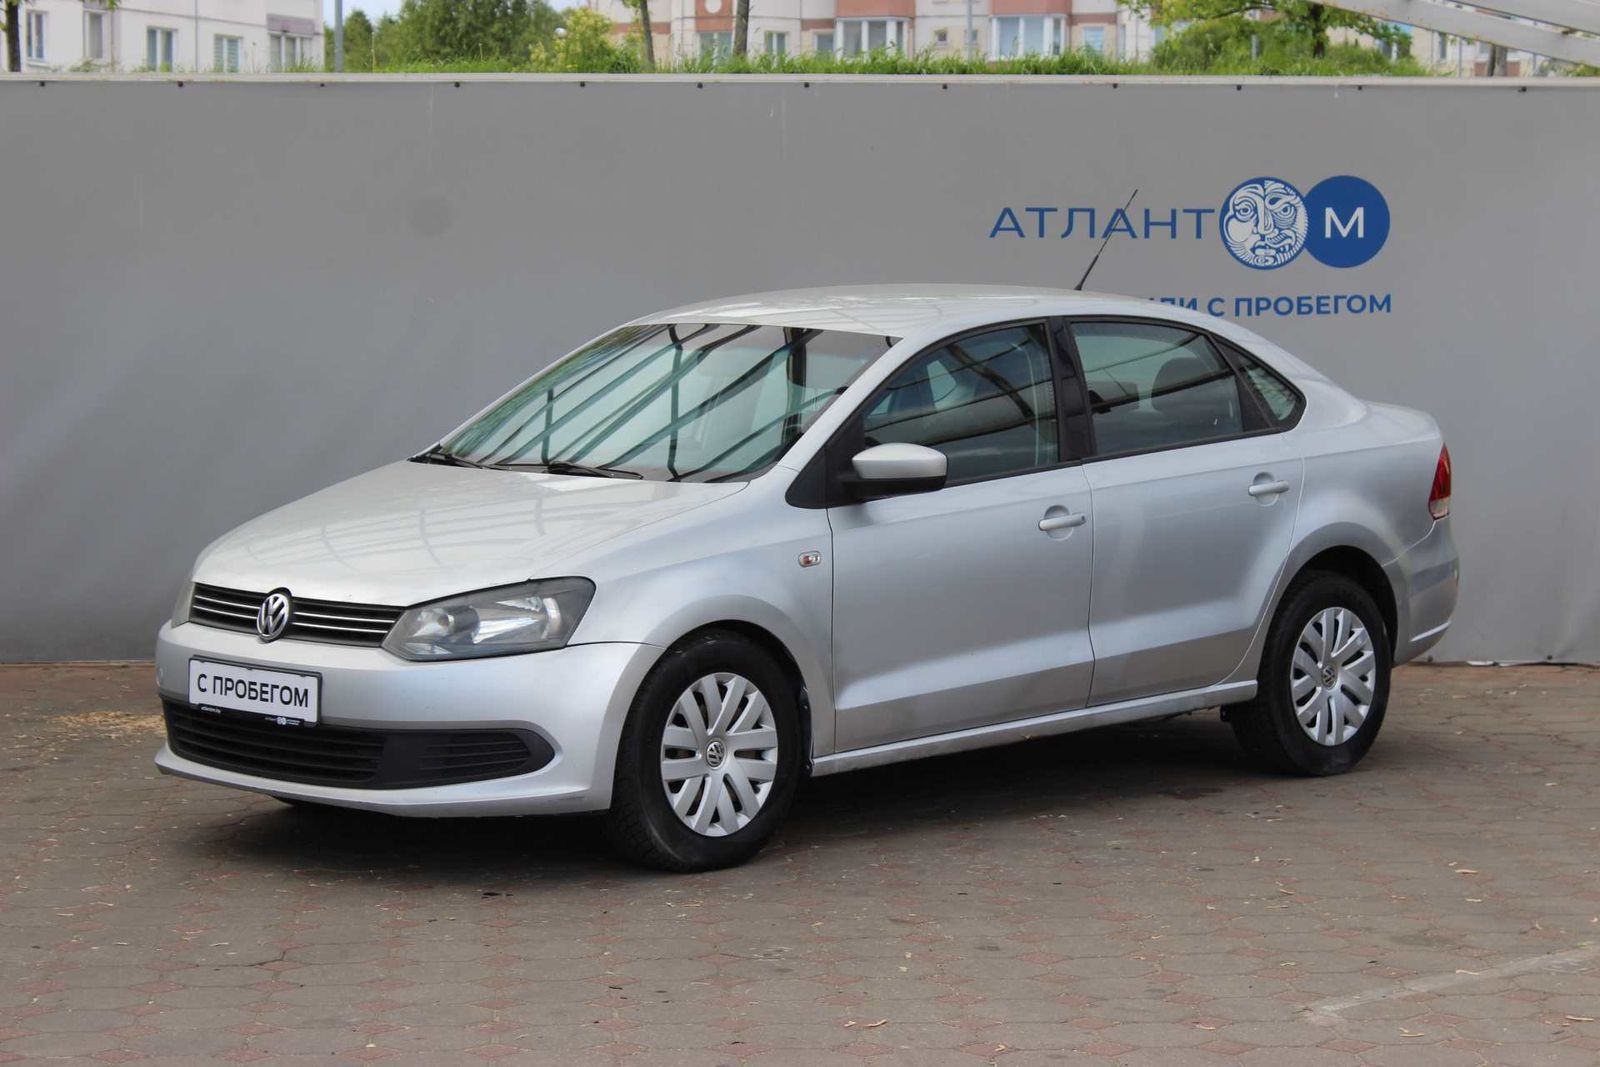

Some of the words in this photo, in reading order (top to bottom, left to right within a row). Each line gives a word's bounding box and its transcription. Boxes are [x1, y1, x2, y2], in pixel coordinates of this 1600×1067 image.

[989, 206, 1216, 240] АТЛАНТ
[1324, 206, 1365, 239] М
[1207, 296, 1225, 318] С
[1234, 294, 1392, 318] ПРОБЕГОМ
[197, 673, 208, 693] С
[212, 675, 309, 708] ПРОБЕГОМ
